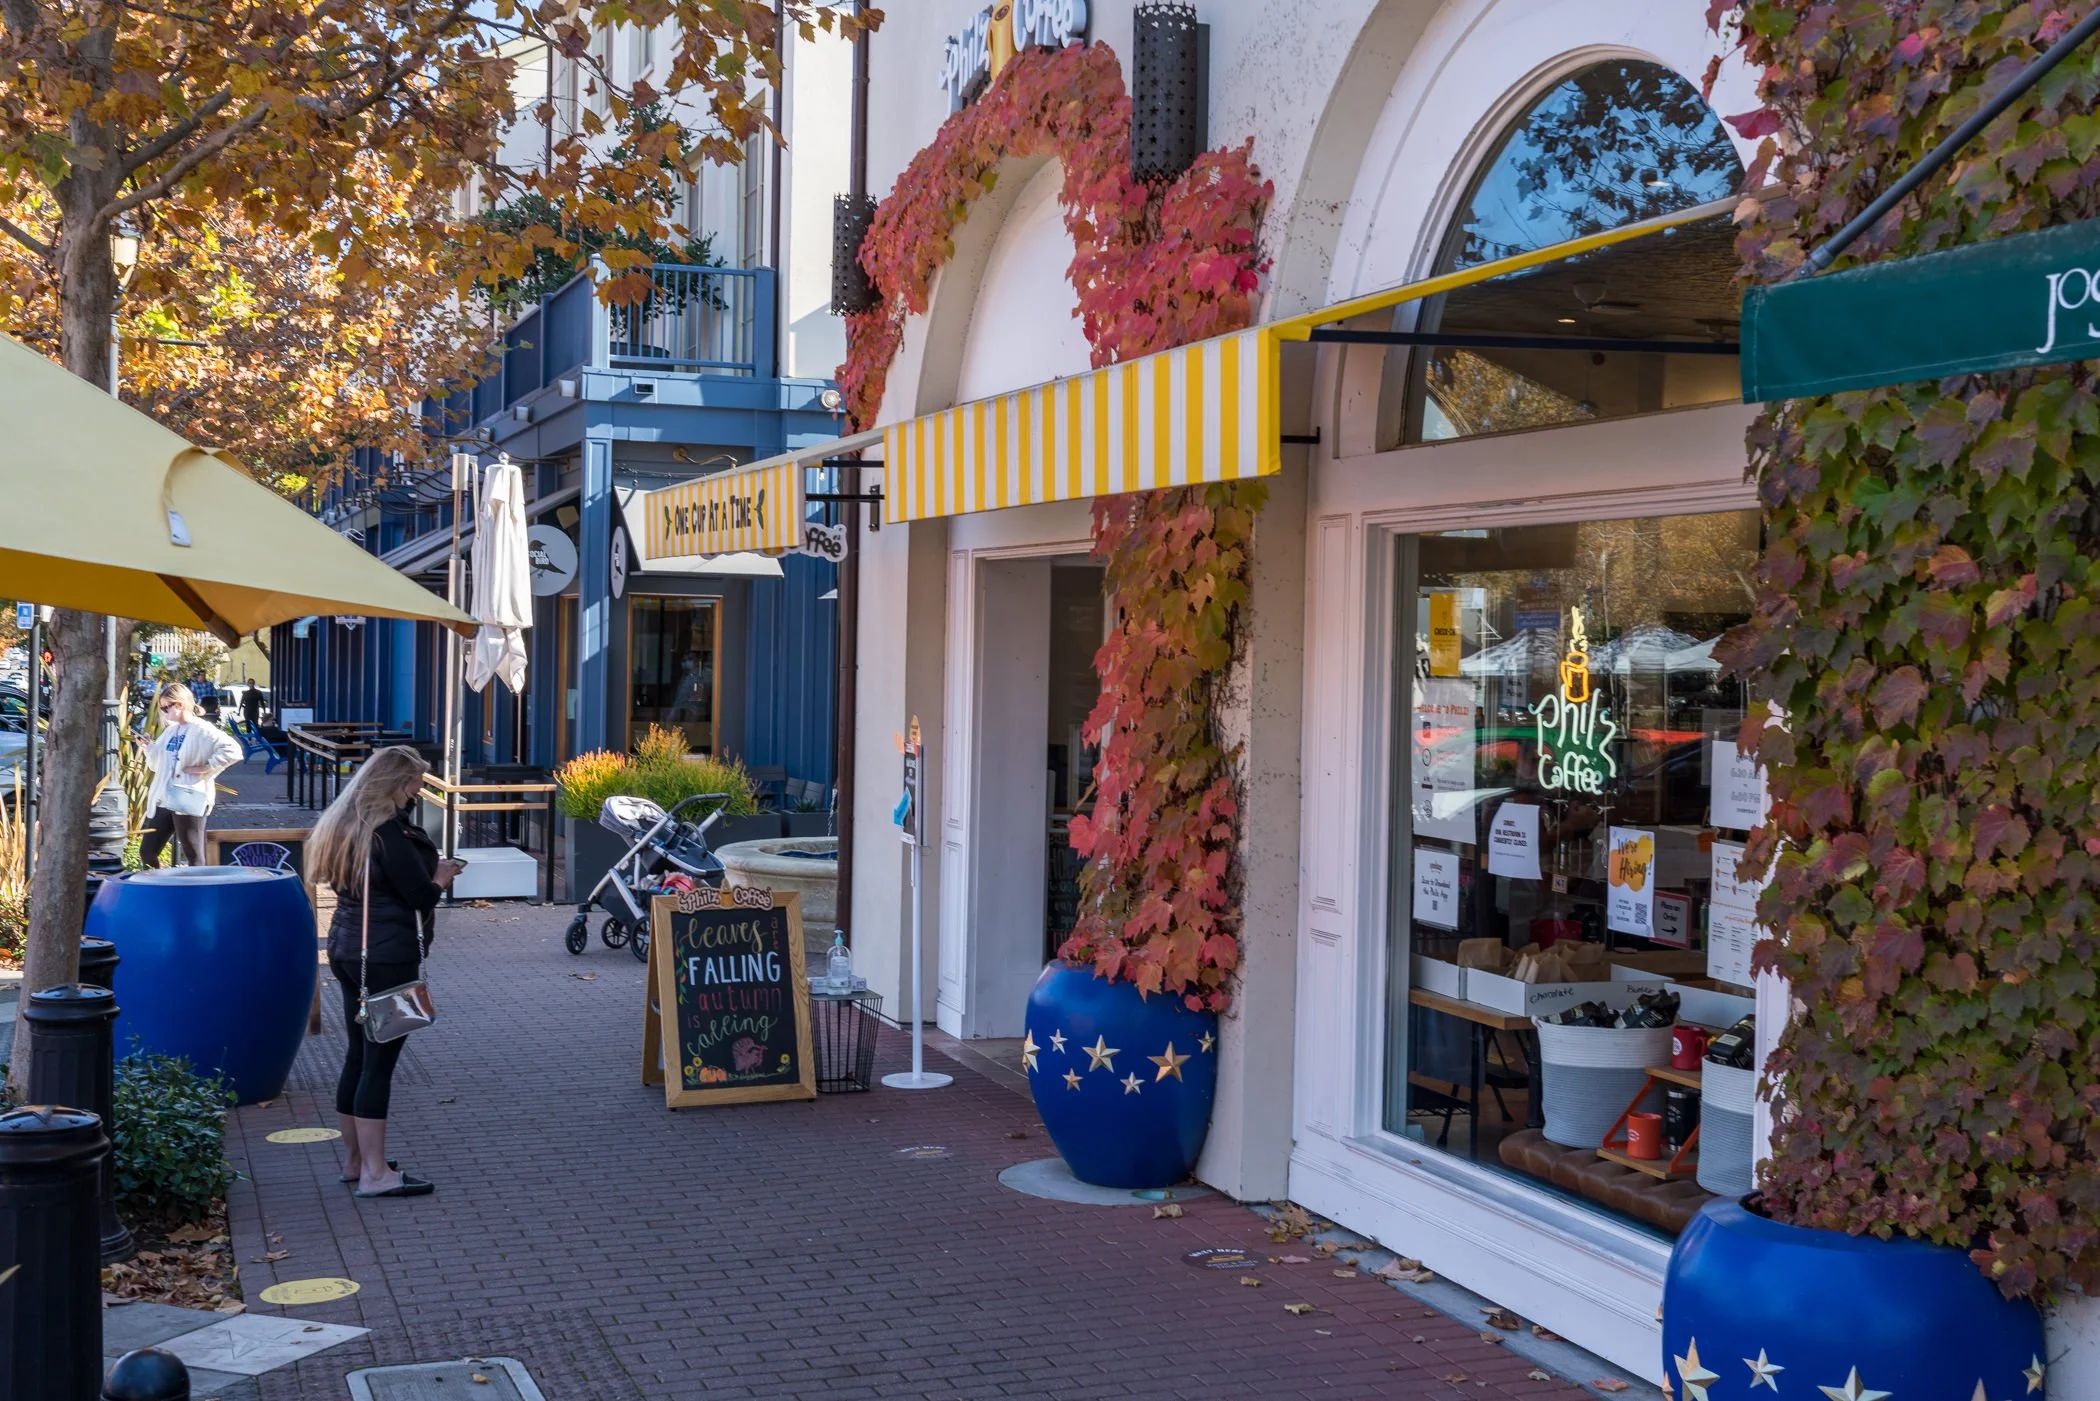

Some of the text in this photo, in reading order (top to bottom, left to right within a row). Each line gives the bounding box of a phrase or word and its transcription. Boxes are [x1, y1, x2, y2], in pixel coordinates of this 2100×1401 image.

[2036, 267, 2100, 351] JO
[674, 495, 752, 536] ONE CUP AT A TIME
[1538, 751, 1604, 795] Coffee
[680, 887, 774, 911] Philz Coffee
[682, 917, 768, 953] leaves
[688, 951, 781, 986] FALLING
[700, 984, 782, 1012] autumn
[687, 1013, 779, 1057] calling
[688, 1015, 700, 1029] is
